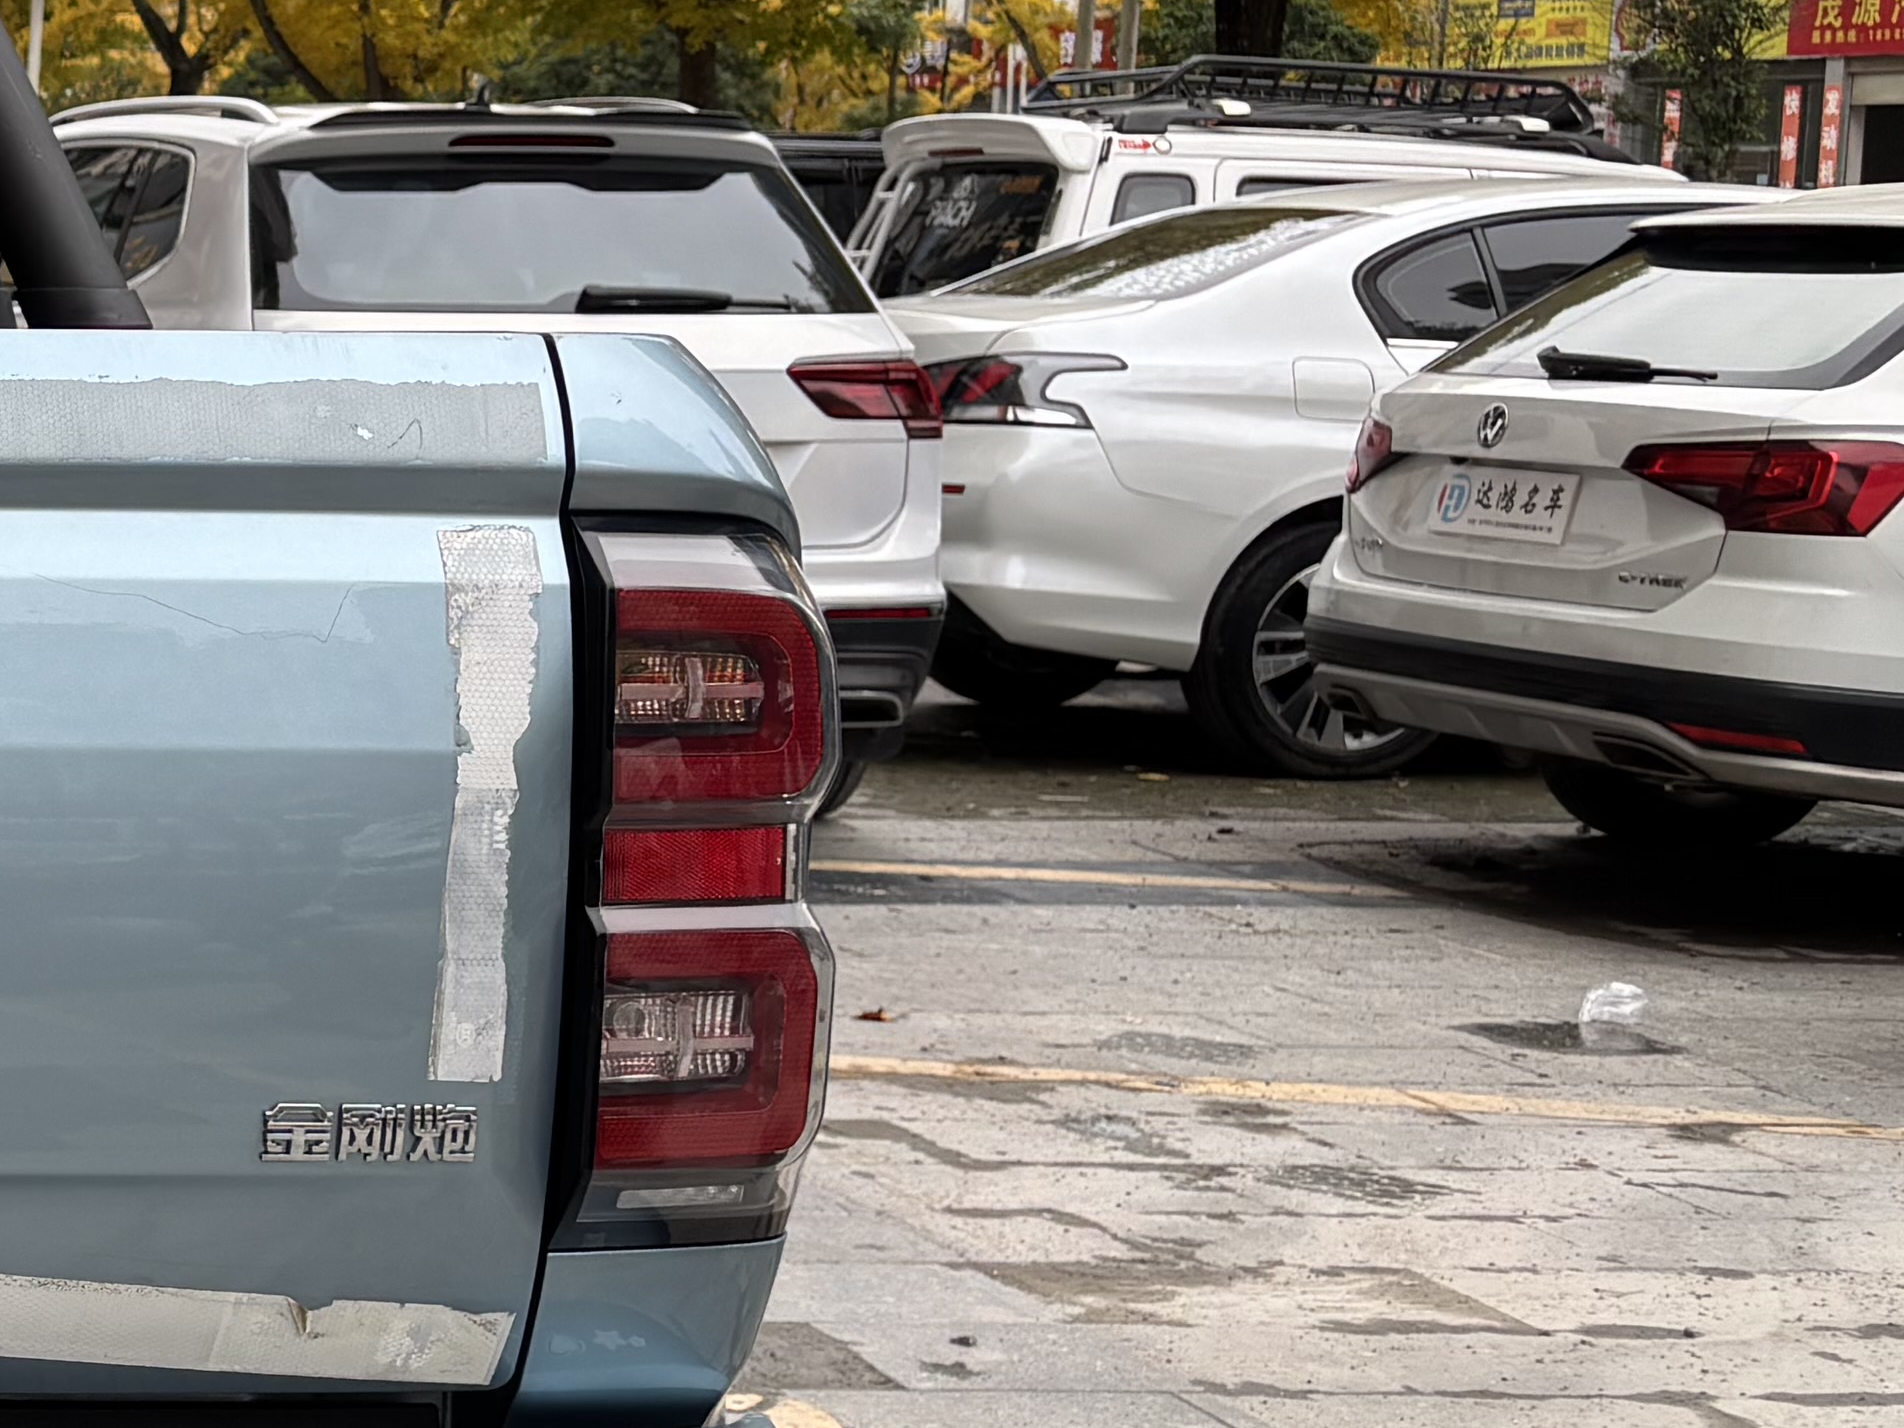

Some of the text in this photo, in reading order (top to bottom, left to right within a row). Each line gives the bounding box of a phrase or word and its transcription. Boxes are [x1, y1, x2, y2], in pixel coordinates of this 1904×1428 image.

[1474, 479, 1566, 519] 达鸿名车
[259, 1102, 478, 1163] 金刚炮
